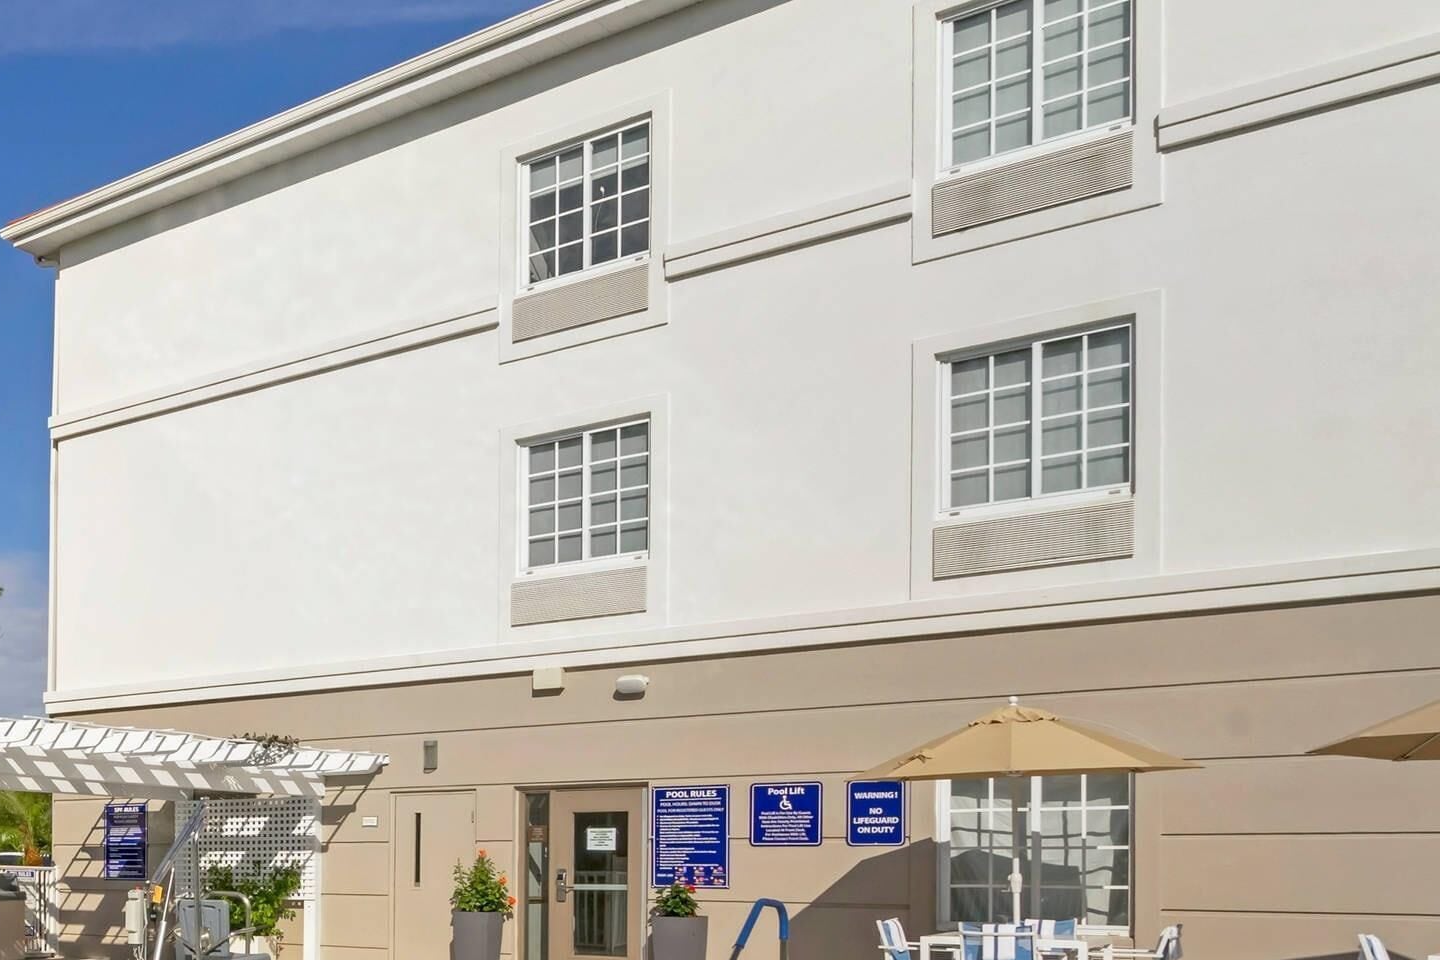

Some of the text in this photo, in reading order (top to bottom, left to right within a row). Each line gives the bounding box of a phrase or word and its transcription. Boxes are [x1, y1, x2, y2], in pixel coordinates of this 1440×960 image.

[666, 789, 717, 798] POOL RULES
[768, 787, 805, 795] Pool Lift
[869, 807, 883, 815] NO
[853, 816, 900, 824] LIFEGUARD
[857, 826, 871, 834] ON
